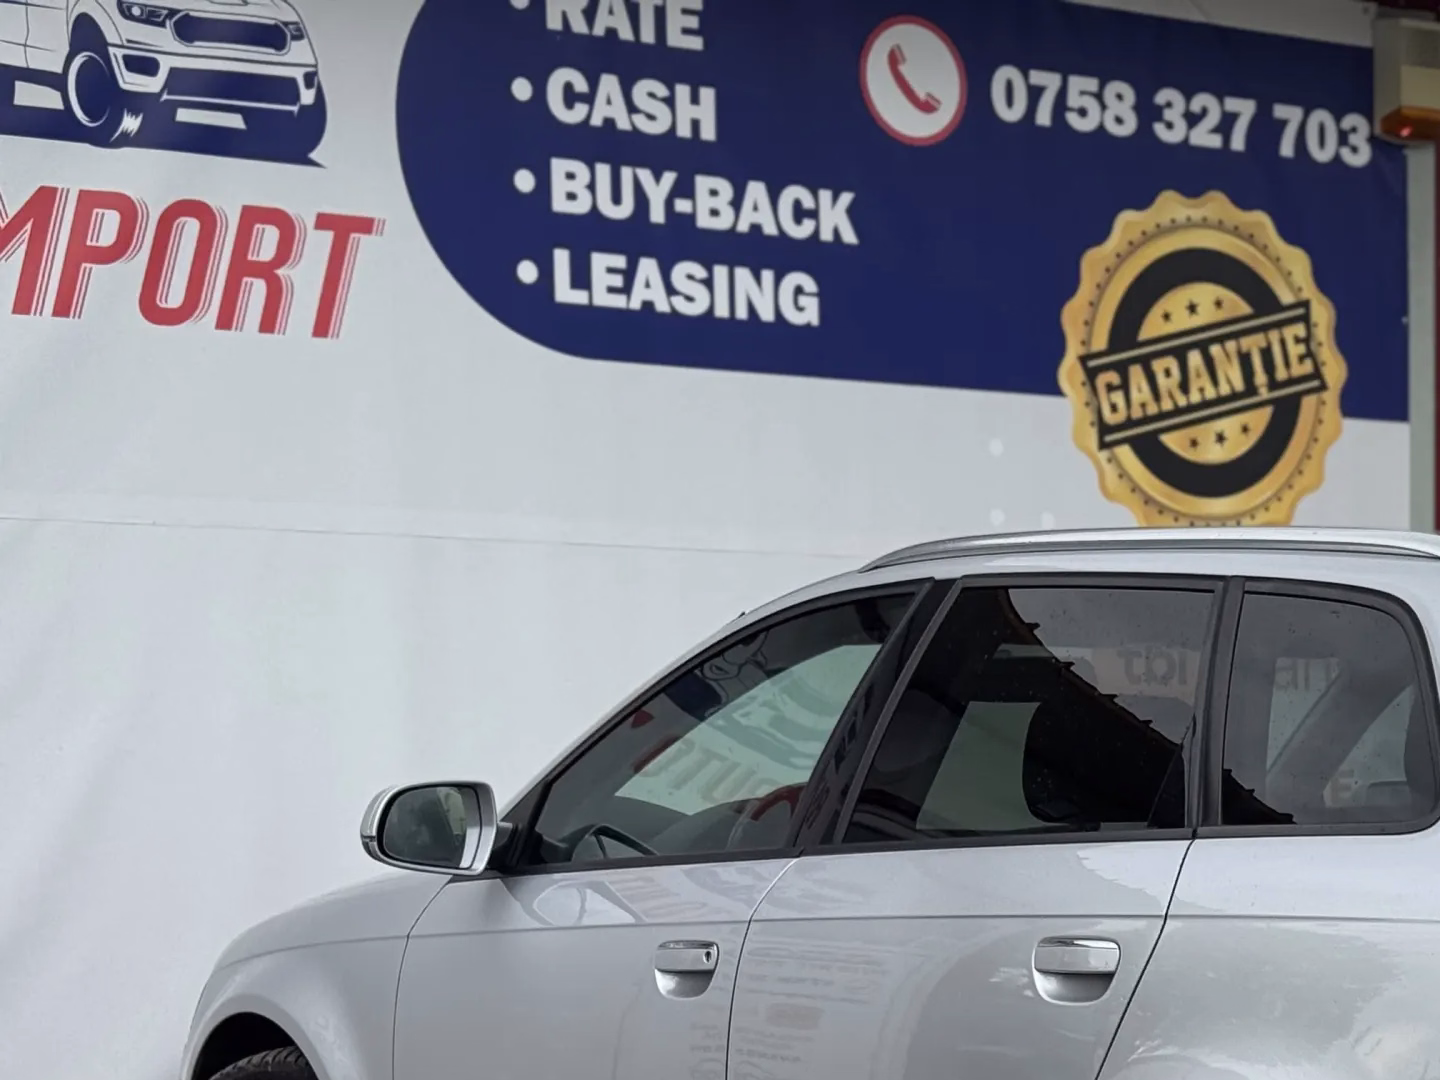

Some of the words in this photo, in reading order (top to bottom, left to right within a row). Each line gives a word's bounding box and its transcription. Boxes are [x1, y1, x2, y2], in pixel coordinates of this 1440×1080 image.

[546, 0, 704, 51] RATE
[546, 66, 716, 142] CASH
[990, 64, 1138, 138] 0758
[1152, 87, 1257, 153] 327
[1272, 102, 1373, 168] 703
[550, 157, 860, 245] BUY-BACK
[553, 248, 822, 327] LEASING
